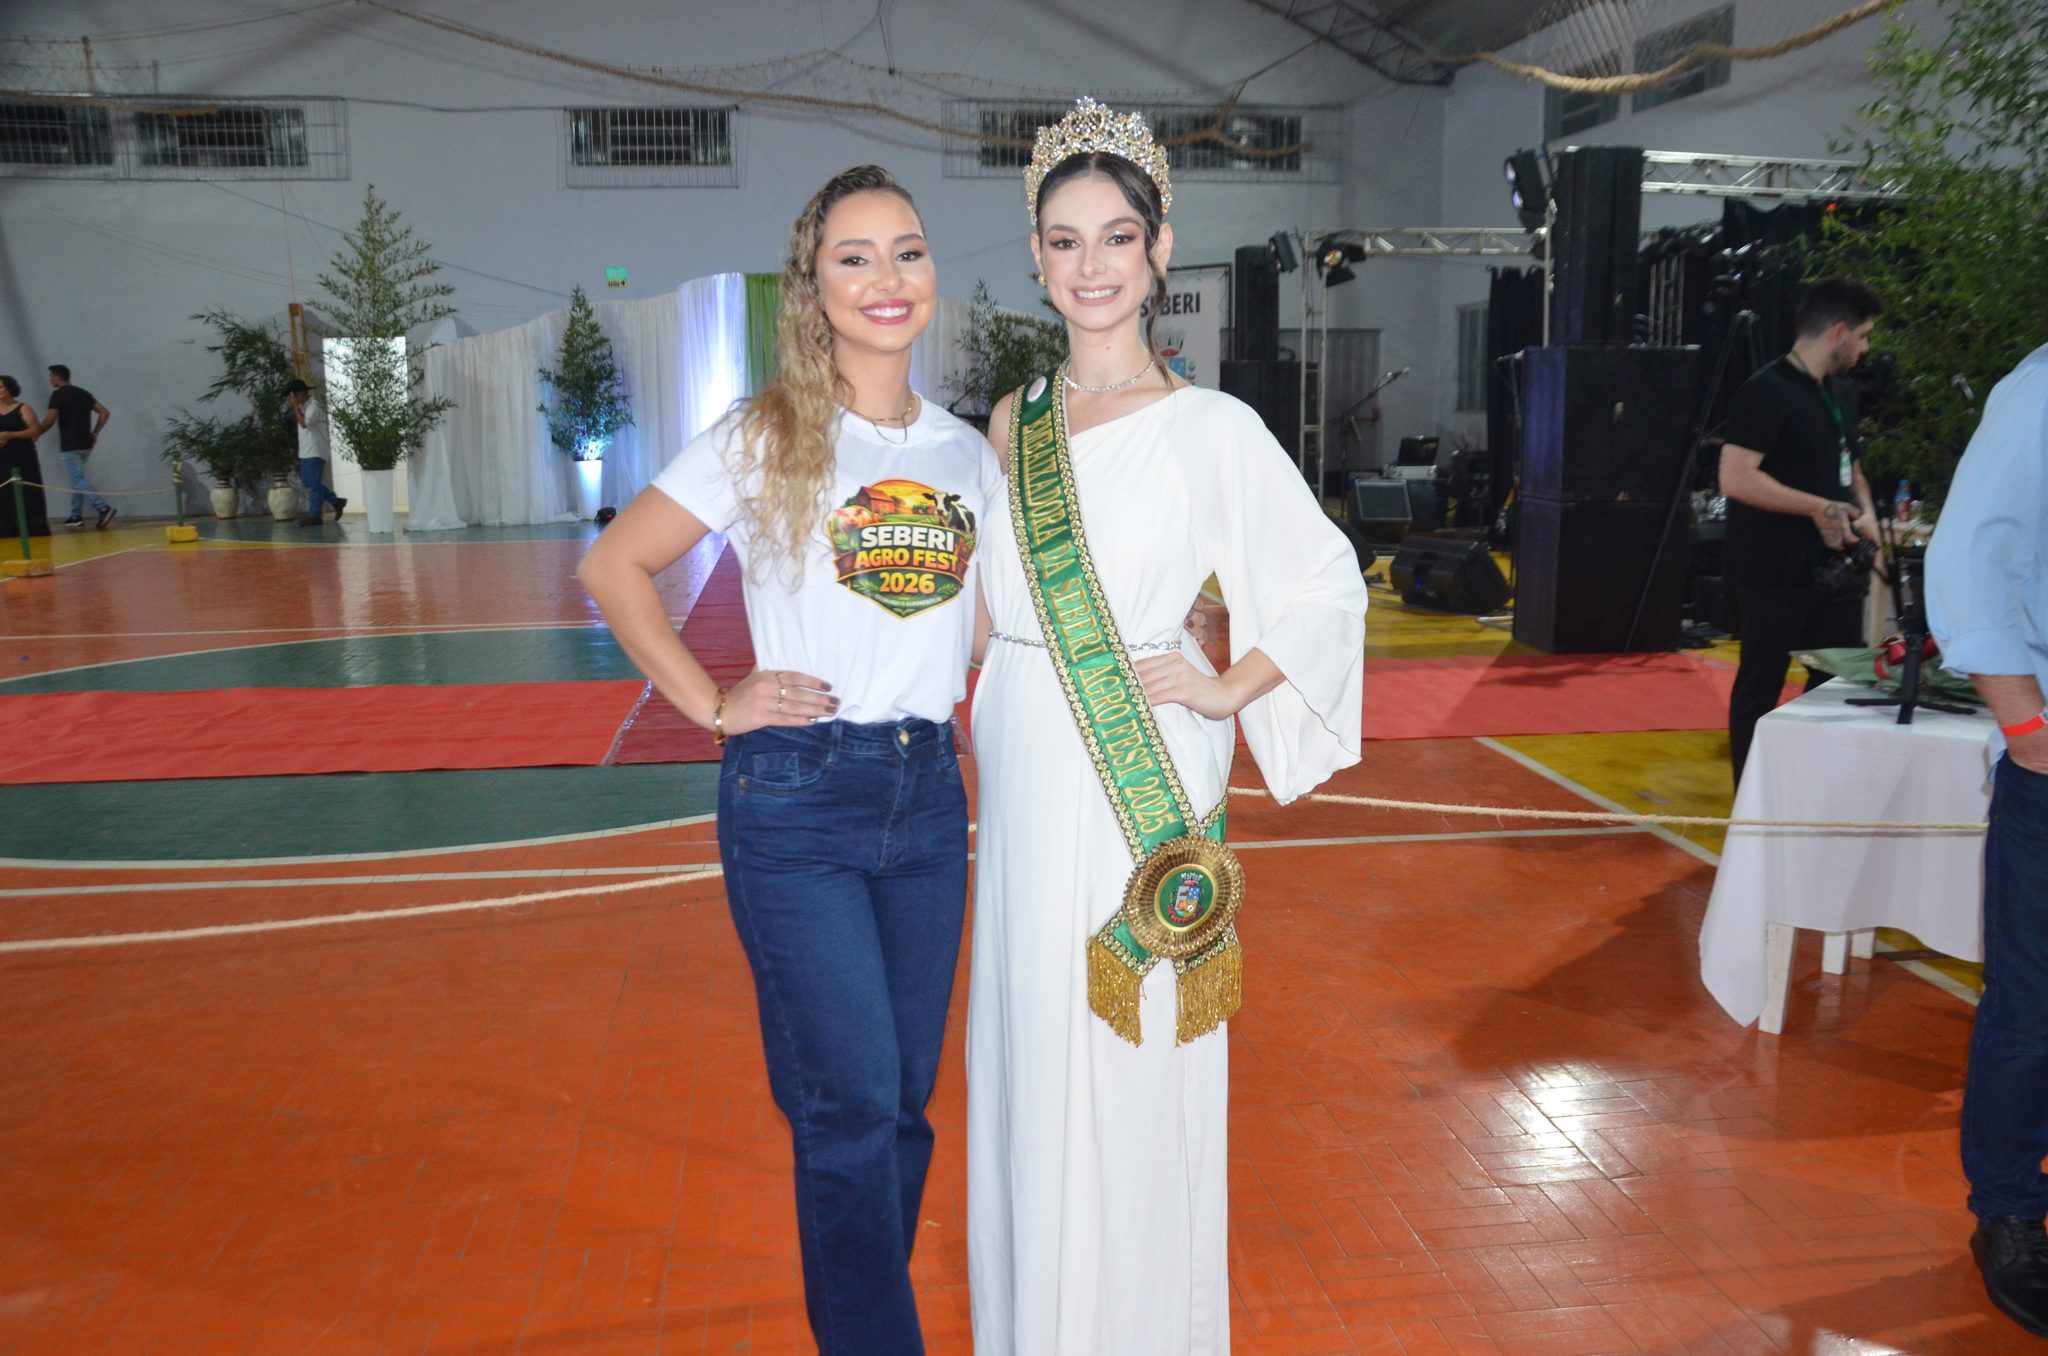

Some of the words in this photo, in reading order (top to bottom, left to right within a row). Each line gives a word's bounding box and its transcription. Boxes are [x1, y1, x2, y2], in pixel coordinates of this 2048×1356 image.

[1140, 291, 1201, 318] SBERI
[861, 525, 954, 552] SEBERI
[853, 548, 910, 569] AGRO
[912, 549, 958, 572] FEST
[1037, 540, 1076, 579] DA
[879, 571, 936, 595] 2026
[1048, 577, 1108, 663] SEBERI
[1078, 664, 1132, 723] AGRO
[1100, 719, 1154, 778] FEST
[1123, 776, 1179, 834] 2025
